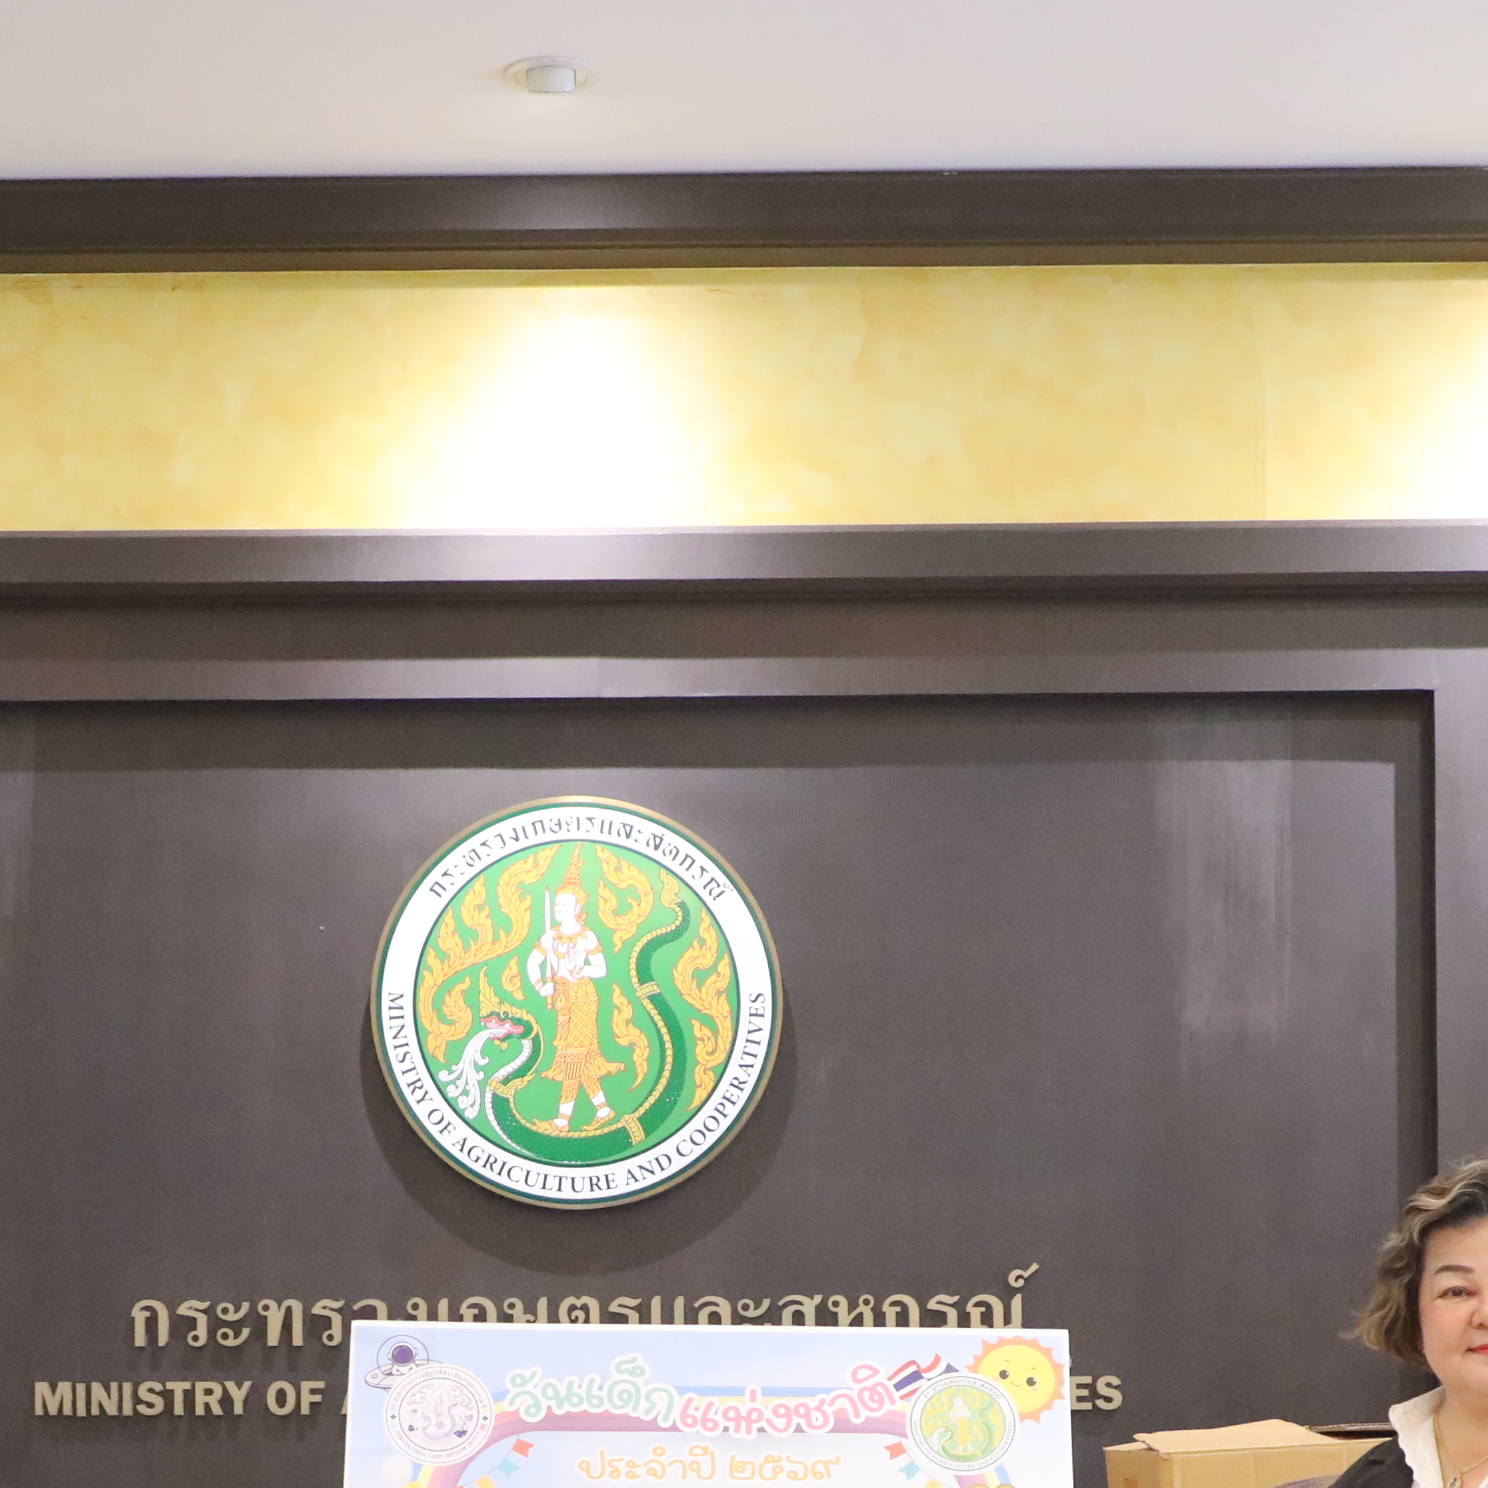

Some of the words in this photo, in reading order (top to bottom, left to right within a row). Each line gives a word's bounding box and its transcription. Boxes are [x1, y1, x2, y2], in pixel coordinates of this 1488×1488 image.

[427, 814, 735, 903] กระทรวงเกษตรและสหกรณ์
[387, 991, 432, 1112] MINISTRY
[426, 1108, 457, 1151] OF
[450, 1136, 619, 1194] AGRICULTURE
[622, 1153, 673, 1190] AND
[675, 990, 767, 1160] COOPERATIVES
[34, 1381, 253, 1418] MINISTRY
[266, 1381, 326, 1416] OF
[508, 1354, 897, 1436] วันเด็กแห่งชาติ
[578, 1444, 716, 1482] ประจำปี
[728, 1453, 841, 1482] ๒๕๖๙
